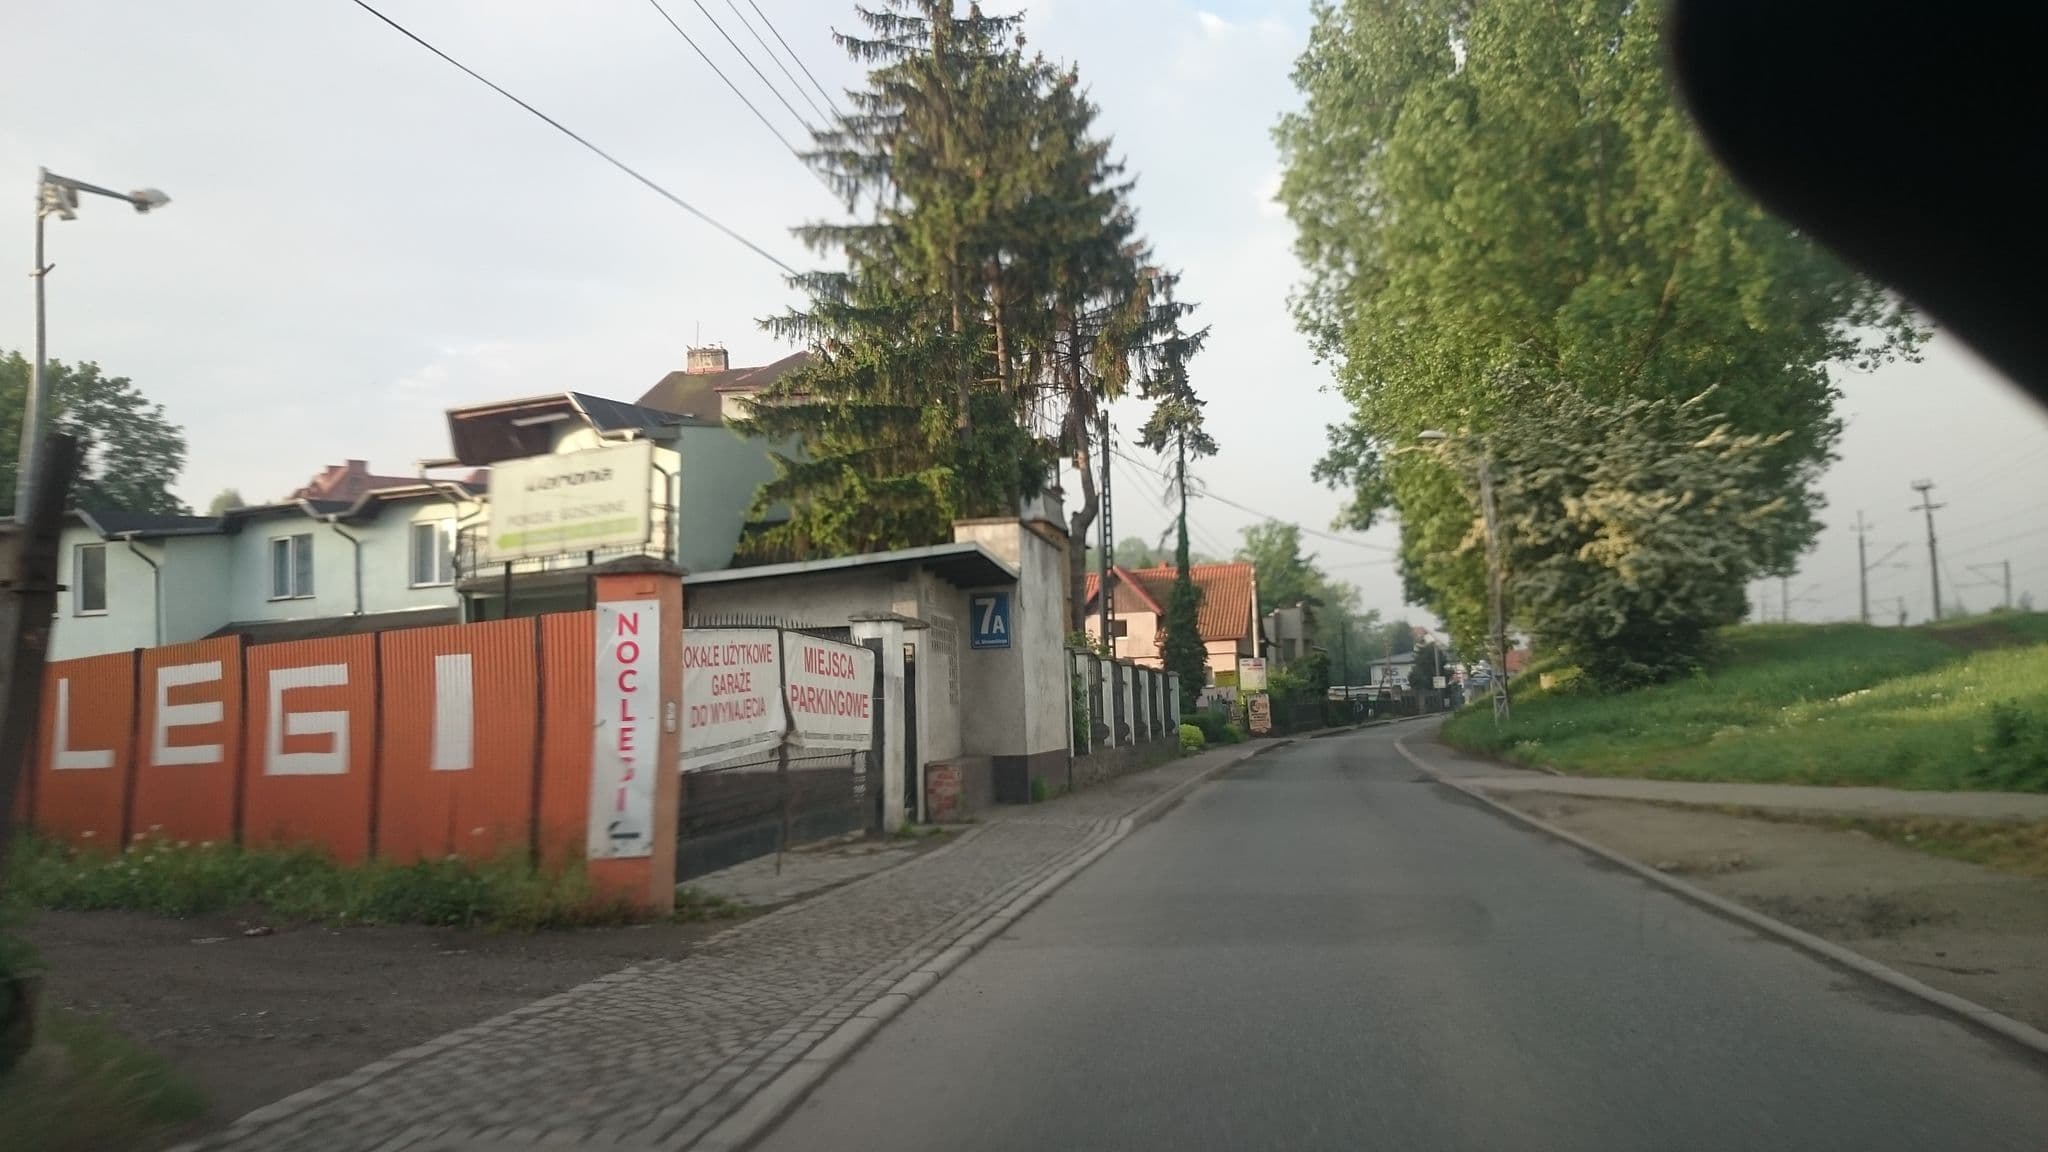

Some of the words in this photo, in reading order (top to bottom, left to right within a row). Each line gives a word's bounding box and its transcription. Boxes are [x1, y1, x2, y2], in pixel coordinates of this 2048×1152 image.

[682, 644, 720, 669] OKALE
[722, 640, 773, 667] UŻYTKOWE
[804, 646, 856, 680] MIEJSCA
[711, 668, 752, 697] GARAŻE
[790, 684, 870, 719] PARKINGOWE
[691, 705, 707, 729] DO
